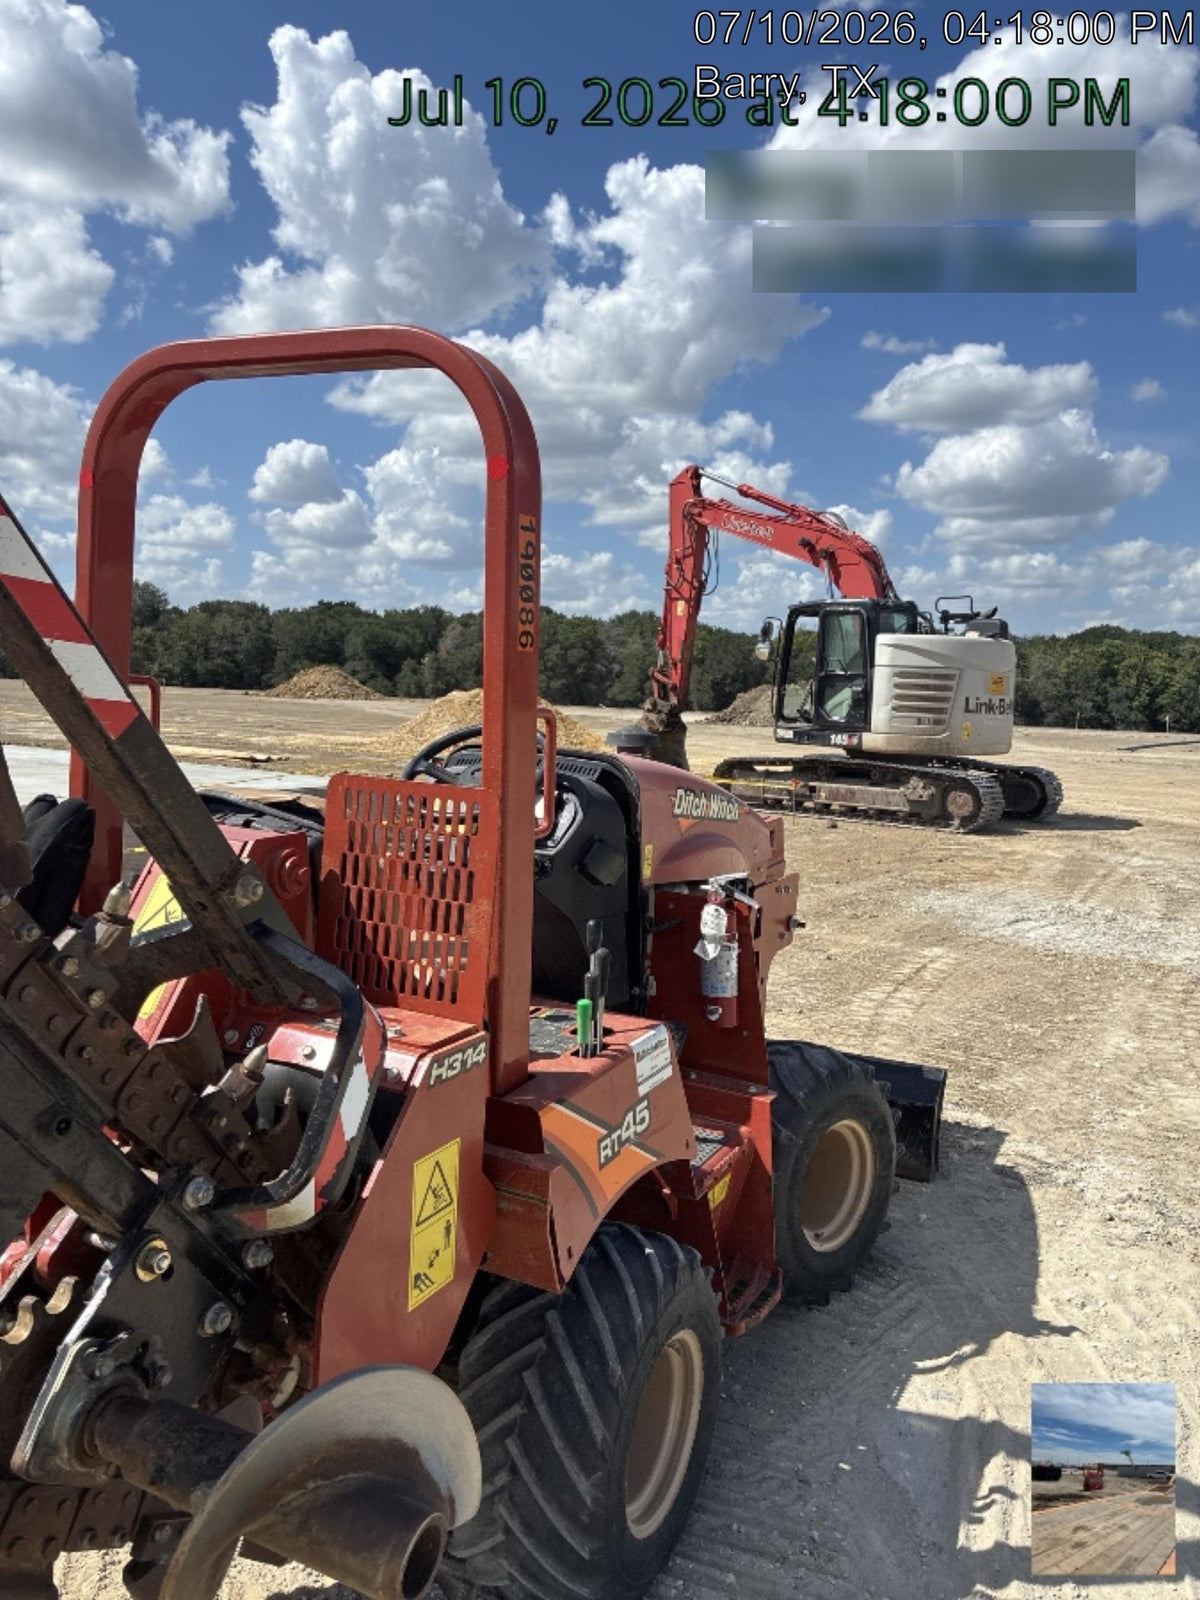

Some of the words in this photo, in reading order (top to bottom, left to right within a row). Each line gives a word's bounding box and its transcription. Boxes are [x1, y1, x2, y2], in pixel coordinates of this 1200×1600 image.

[518, 519, 536, 649] 190086
[673, 788, 707, 817] Ditch
[429, 1040, 487, 1086] H314
[600, 1099, 650, 1164] RT45
